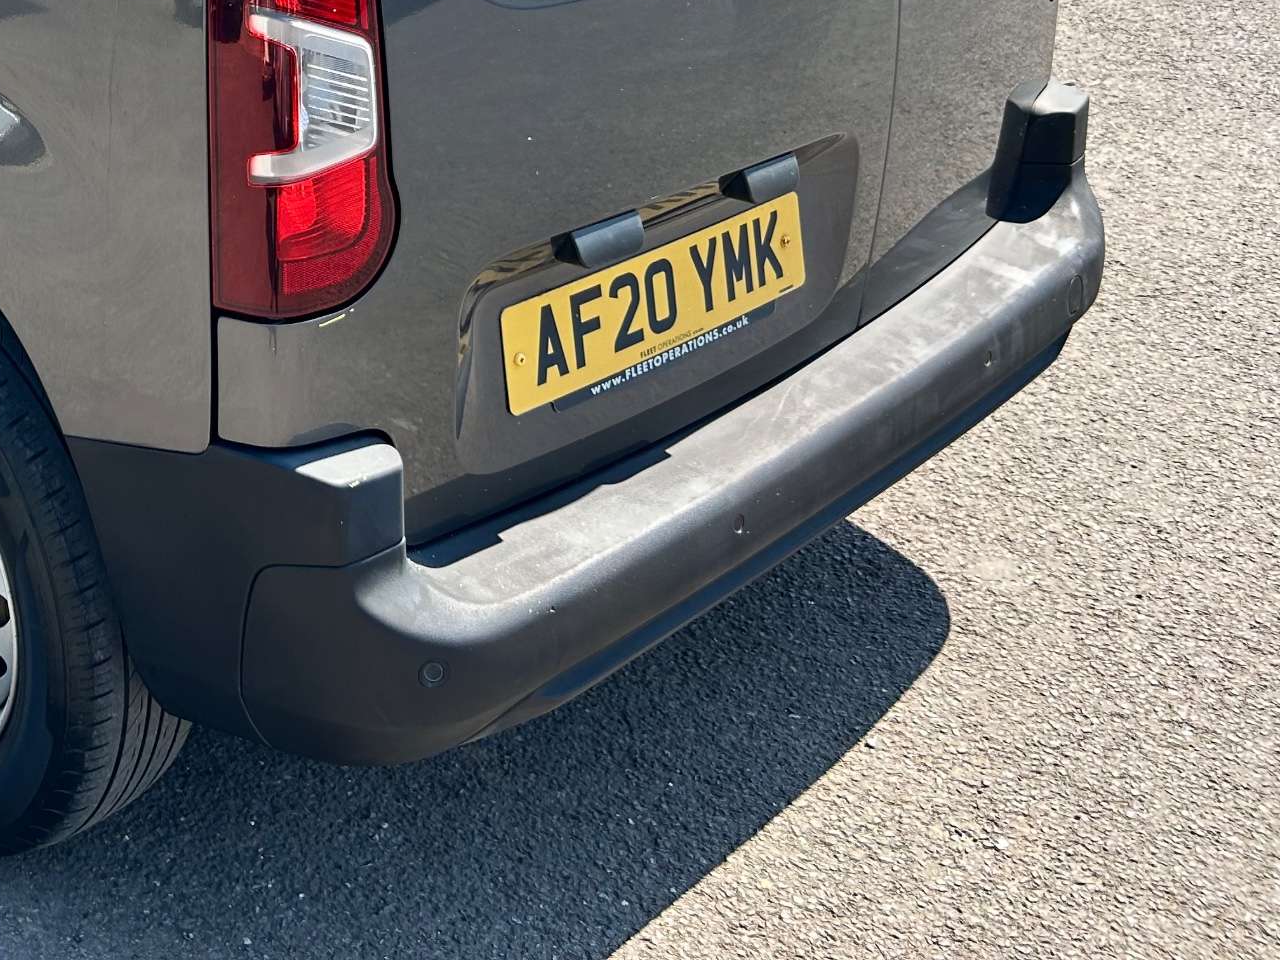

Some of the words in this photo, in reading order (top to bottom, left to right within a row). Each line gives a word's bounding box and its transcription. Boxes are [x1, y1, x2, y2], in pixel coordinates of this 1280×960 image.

[537, 257, 679, 387] AF20
[689, 209, 784, 313] YMK
[590, 315, 750, 396] www.FLEETOPERATIONS.co.uk
[640, 346, 657, 359] FLEET
